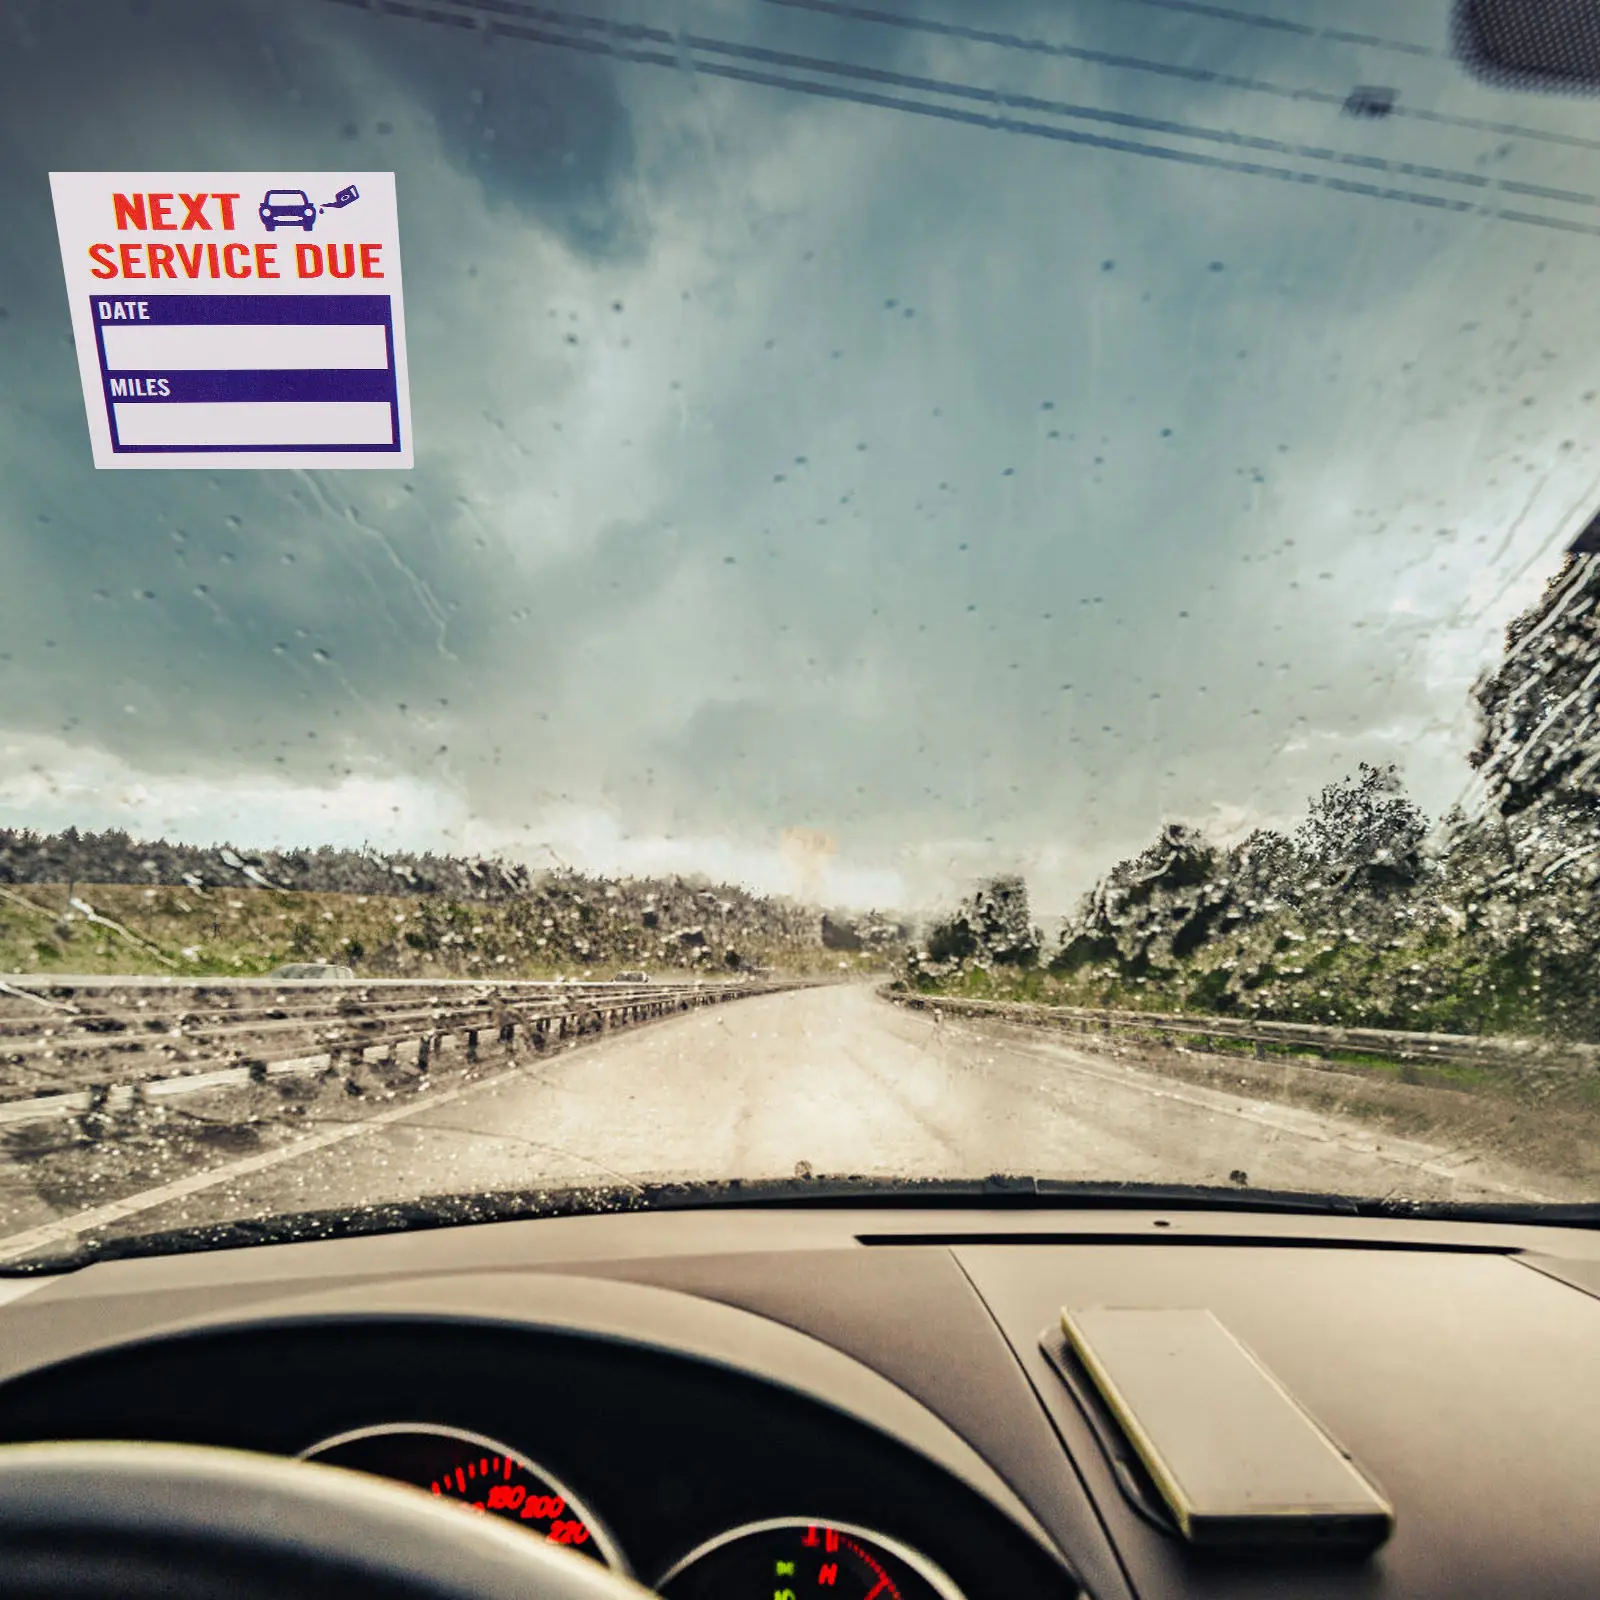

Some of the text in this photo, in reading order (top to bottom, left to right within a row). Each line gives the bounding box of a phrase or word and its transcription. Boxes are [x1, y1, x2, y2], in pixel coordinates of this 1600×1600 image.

[112, 193, 240, 231] NEXT
[88, 243, 385, 279] SERVICE DUE
[98, 301, 150, 320] DATE
[109, 378, 171, 397] MILES
